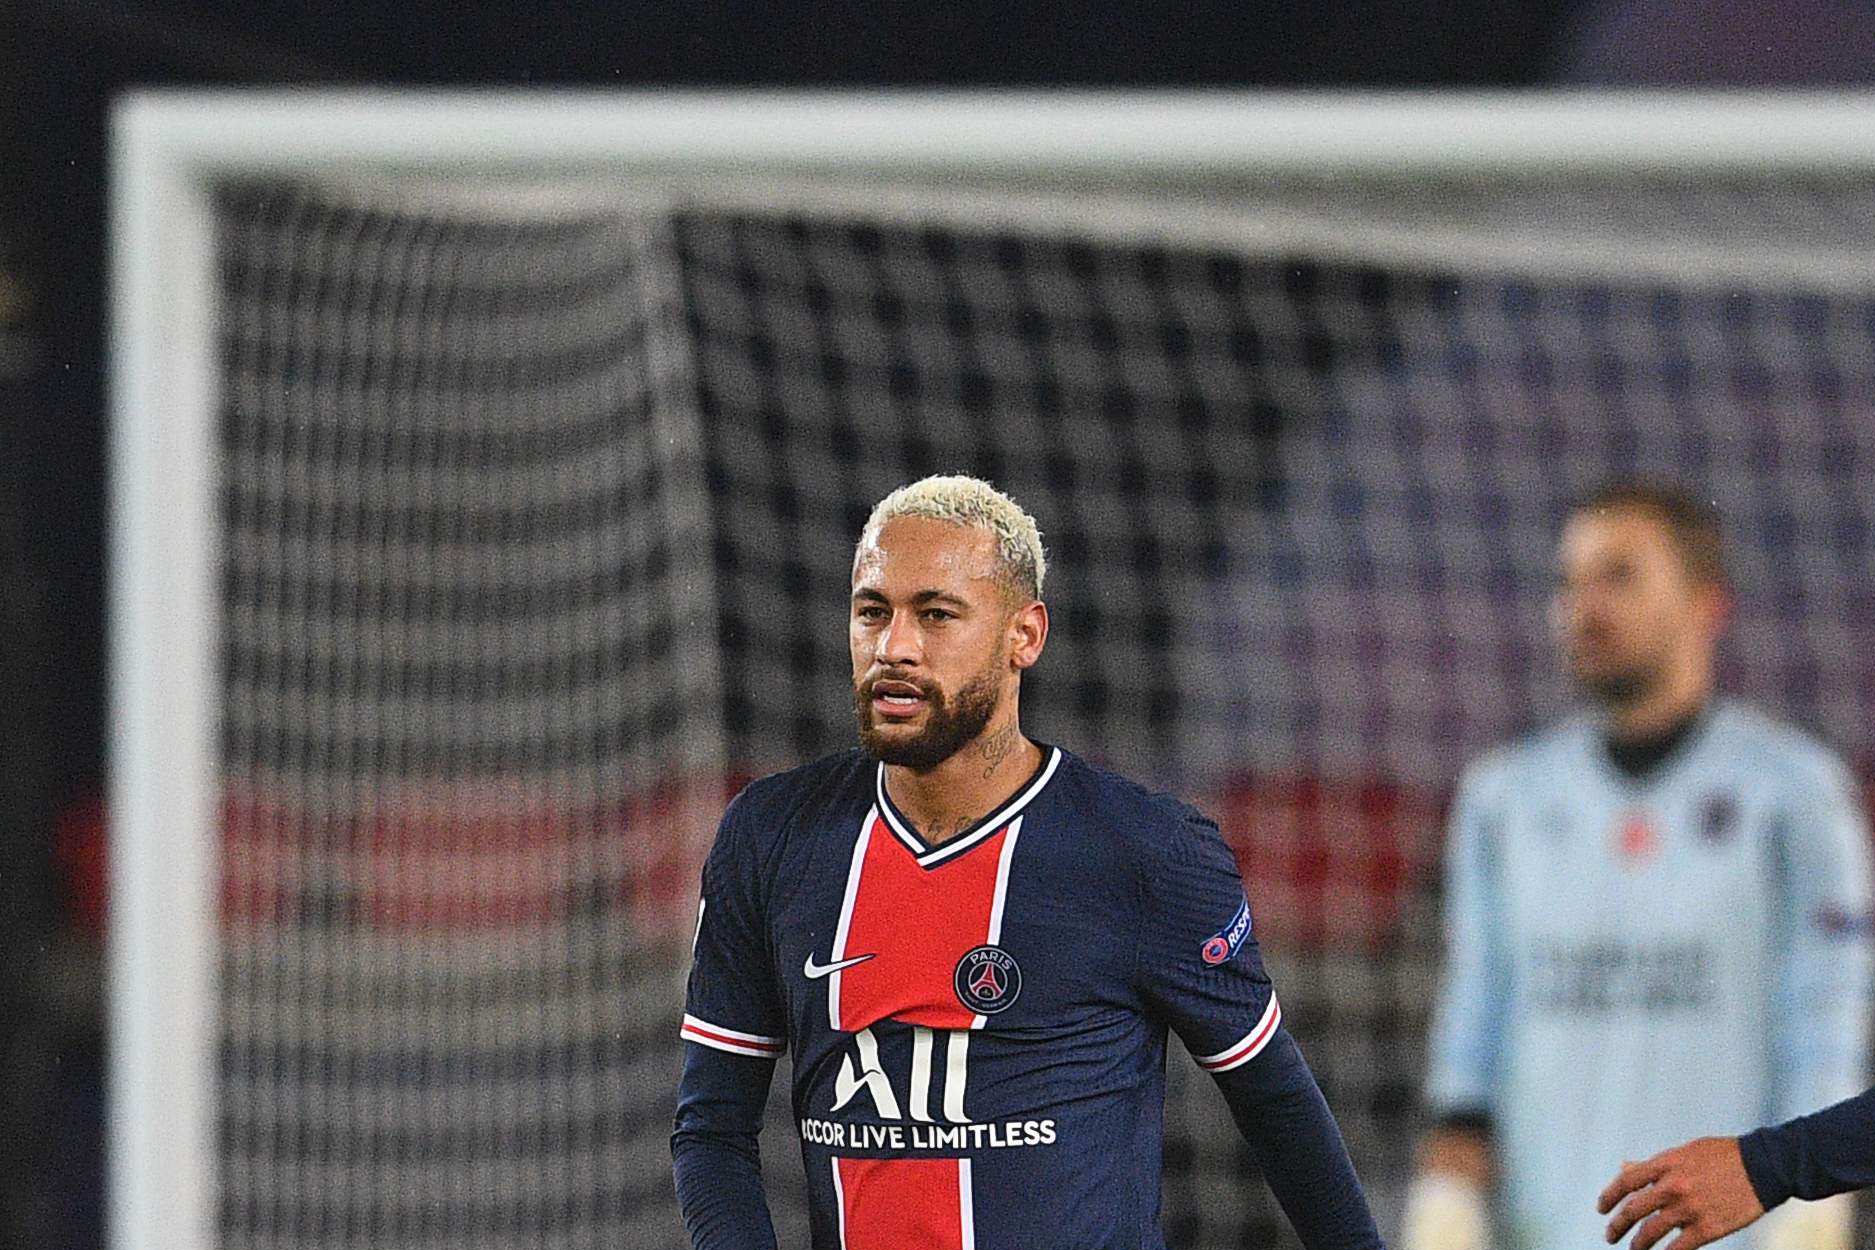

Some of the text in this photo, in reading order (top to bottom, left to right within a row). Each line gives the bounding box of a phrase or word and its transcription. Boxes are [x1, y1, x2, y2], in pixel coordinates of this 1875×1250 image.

[969, 951, 1013, 970] PARIS
[850, 1123, 905, 1149] LIVE
[912, 1119, 1057, 1149] LIMITLESS
